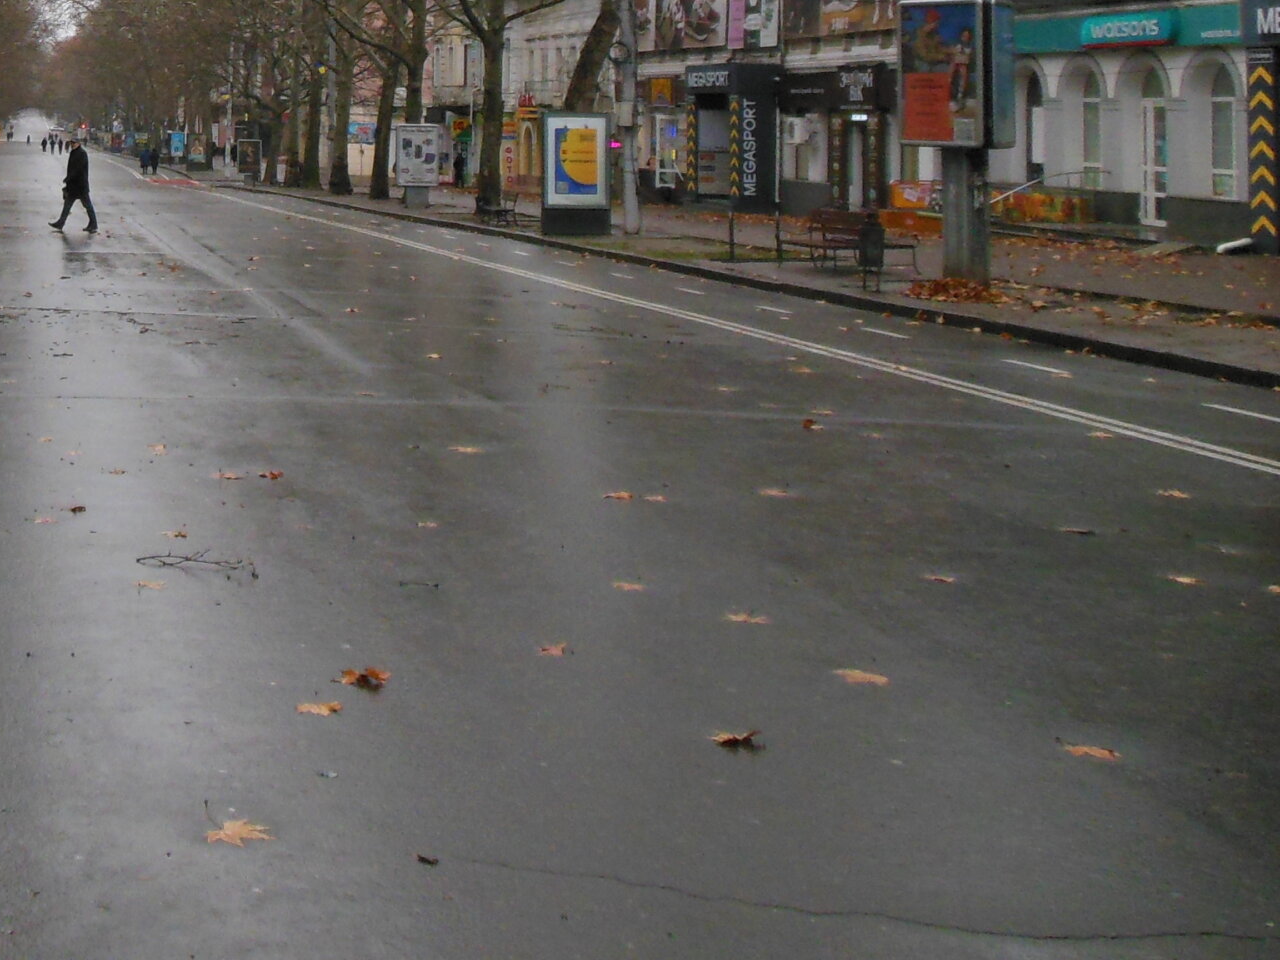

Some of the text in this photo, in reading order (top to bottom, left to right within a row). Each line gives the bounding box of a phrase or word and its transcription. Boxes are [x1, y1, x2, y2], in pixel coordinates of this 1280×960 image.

[1090, 19, 1160, 38] watsons
[687, 70, 729, 88] MEGASPORT
[742, 98, 757, 196] MEGASPORT
